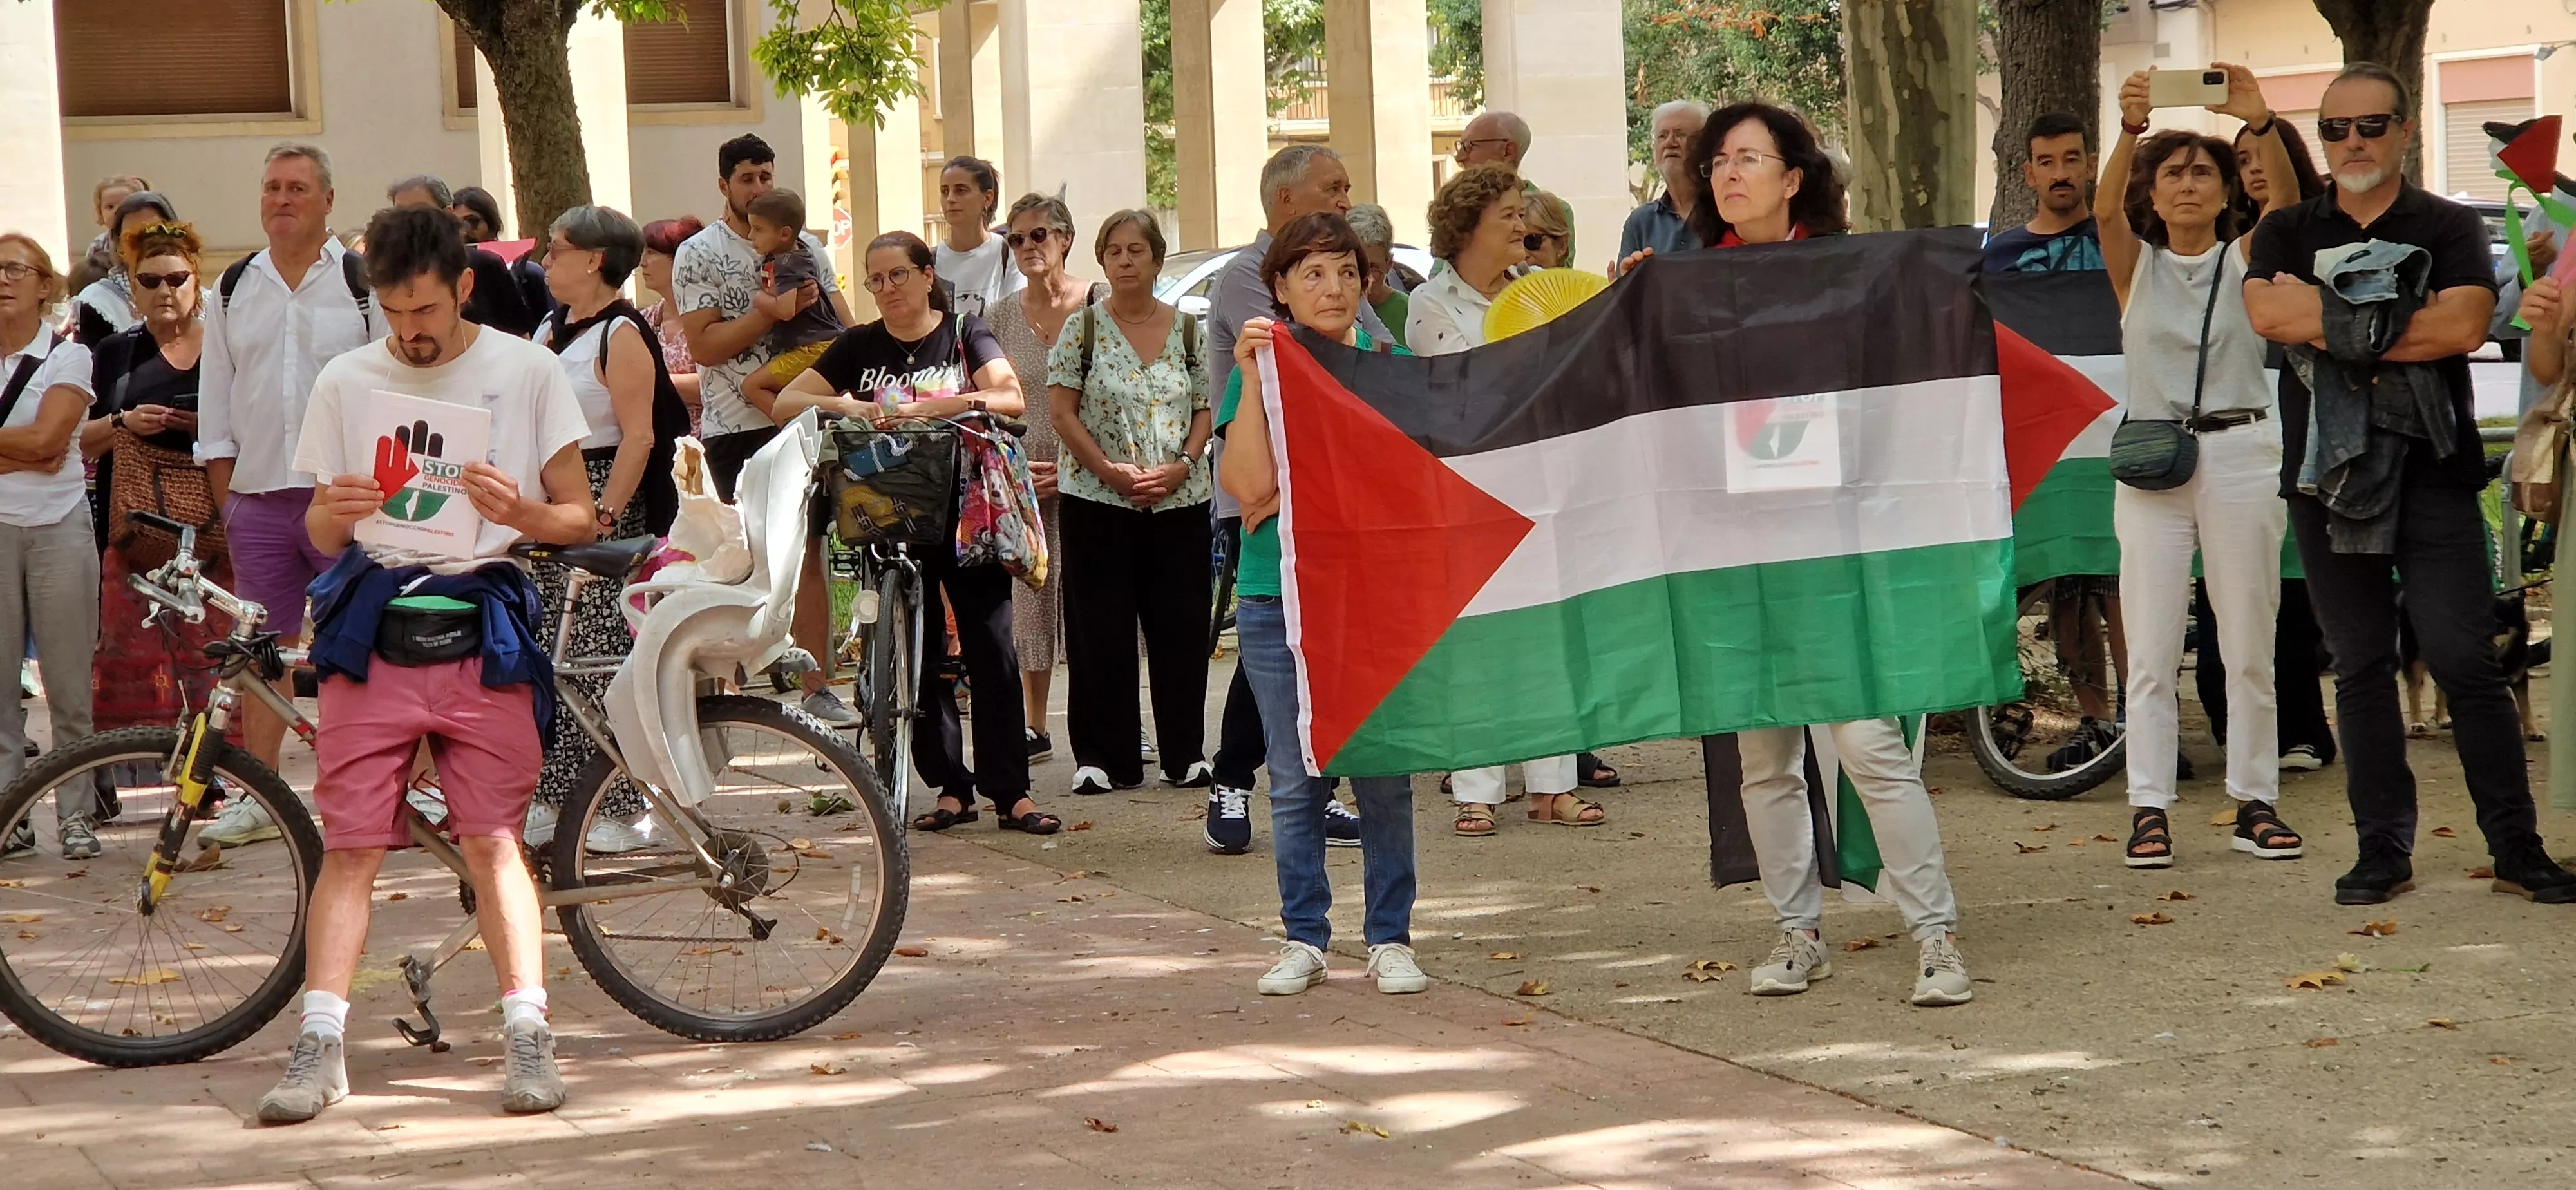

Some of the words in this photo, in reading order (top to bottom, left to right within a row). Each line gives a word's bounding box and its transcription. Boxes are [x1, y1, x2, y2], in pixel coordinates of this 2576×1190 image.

[834, 220, 850, 236] OP
[424, 474, 461, 486] GENOCID
[422, 482, 467, 495] PALESTINO
